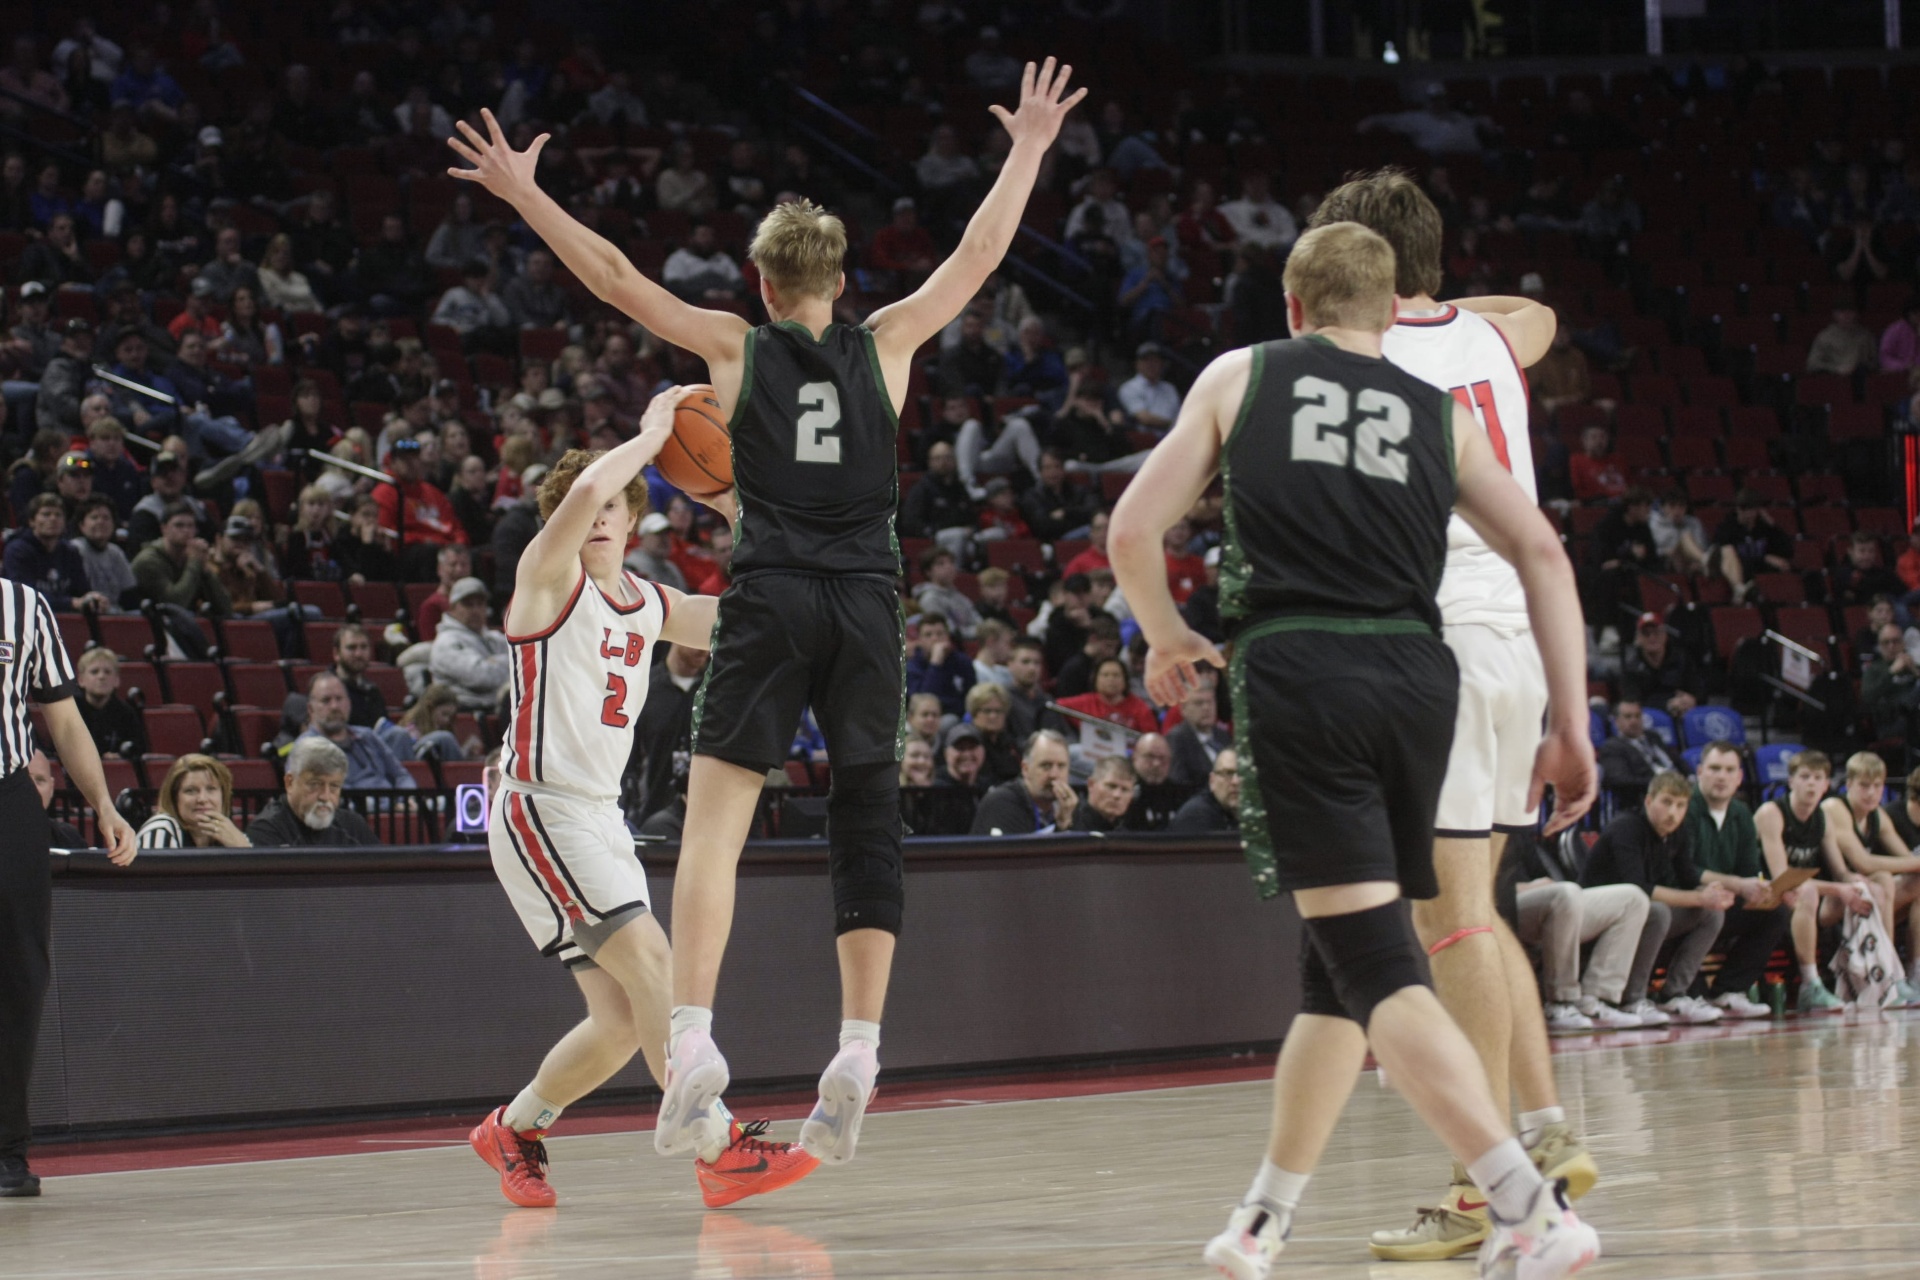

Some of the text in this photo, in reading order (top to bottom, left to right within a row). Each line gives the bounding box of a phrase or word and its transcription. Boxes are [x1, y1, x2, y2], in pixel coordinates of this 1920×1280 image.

[795, 380, 842, 464] 2
[1290, 375, 1412, 484] 22
[601, 672, 630, 728] 2
